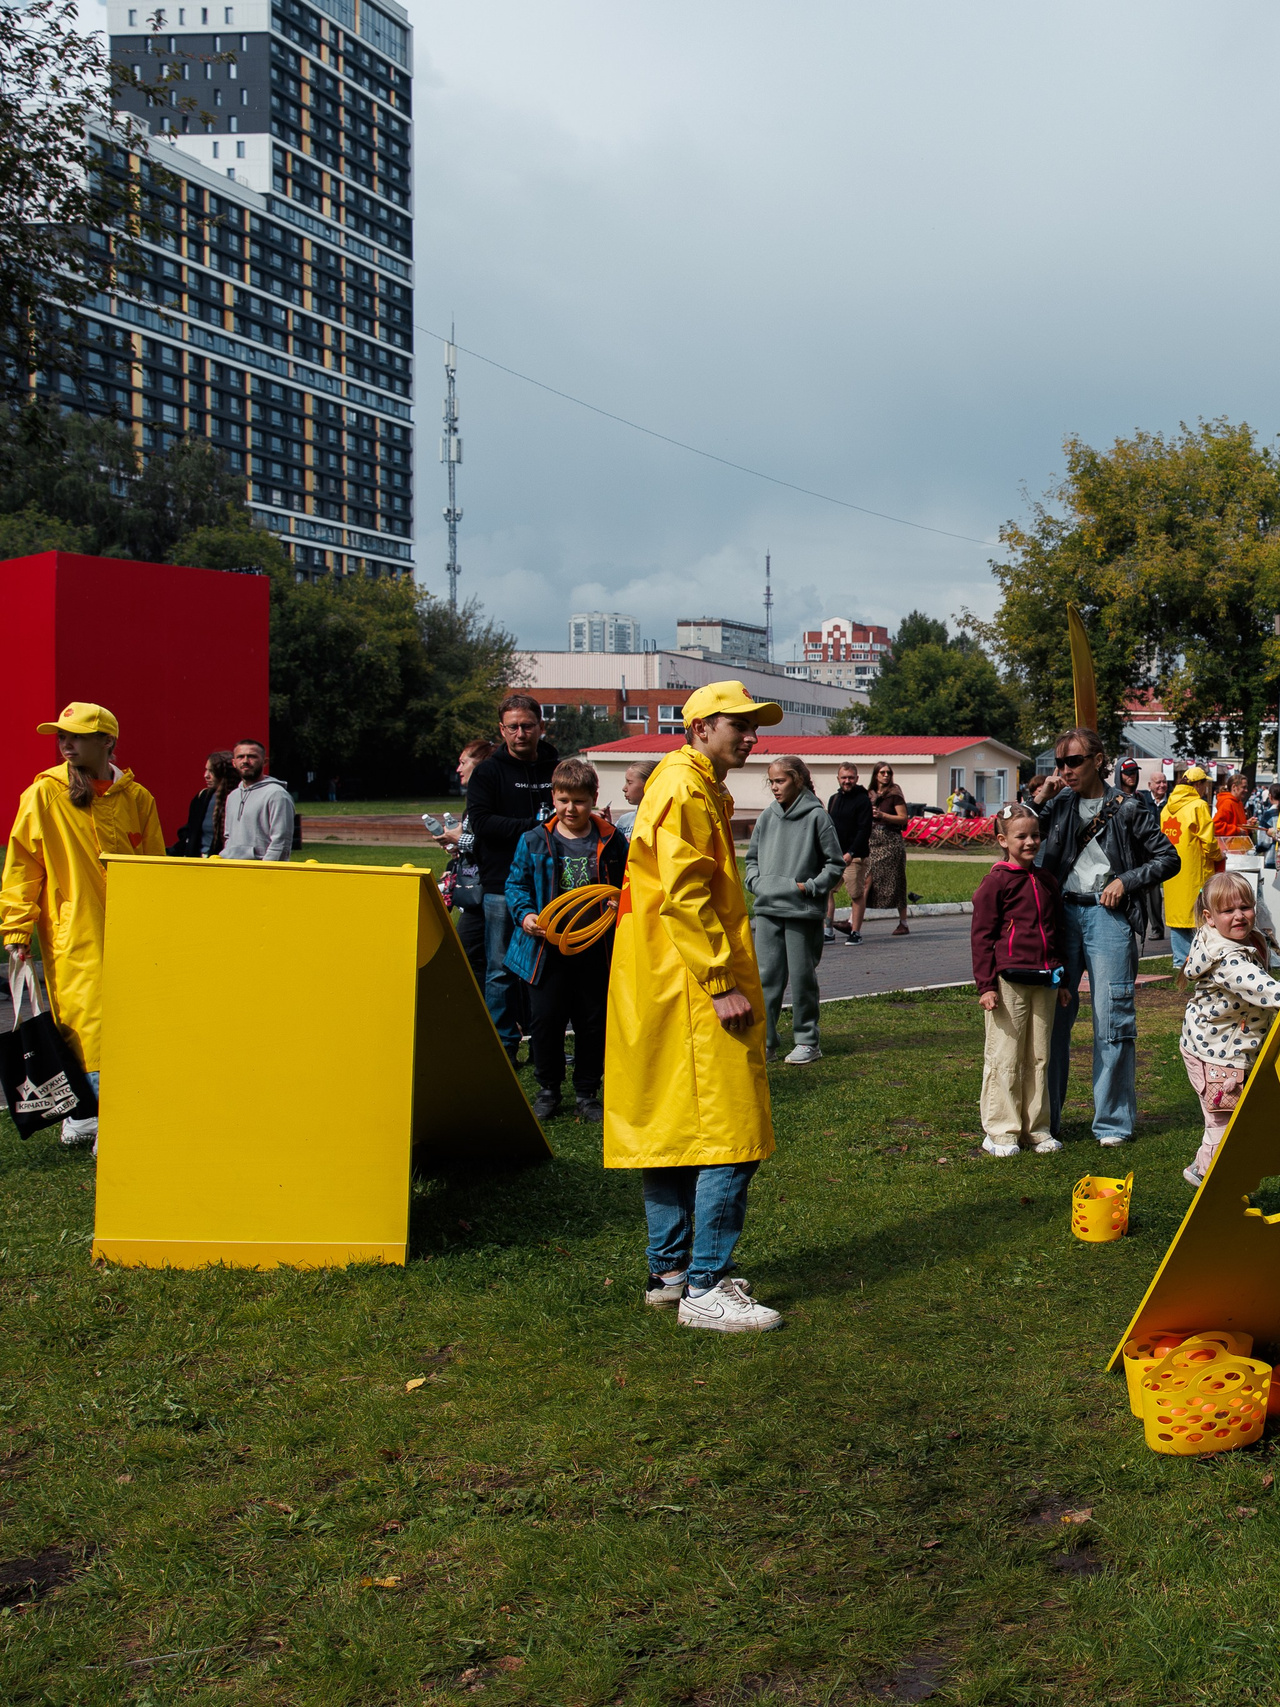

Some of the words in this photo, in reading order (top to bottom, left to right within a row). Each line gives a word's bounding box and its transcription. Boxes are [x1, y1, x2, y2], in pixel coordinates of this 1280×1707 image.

[1164, 828, 1177, 837] СТС
[38, 1074, 67, 1095] НУЖНО
[54, 1087, 72, 1096] ЧТО
